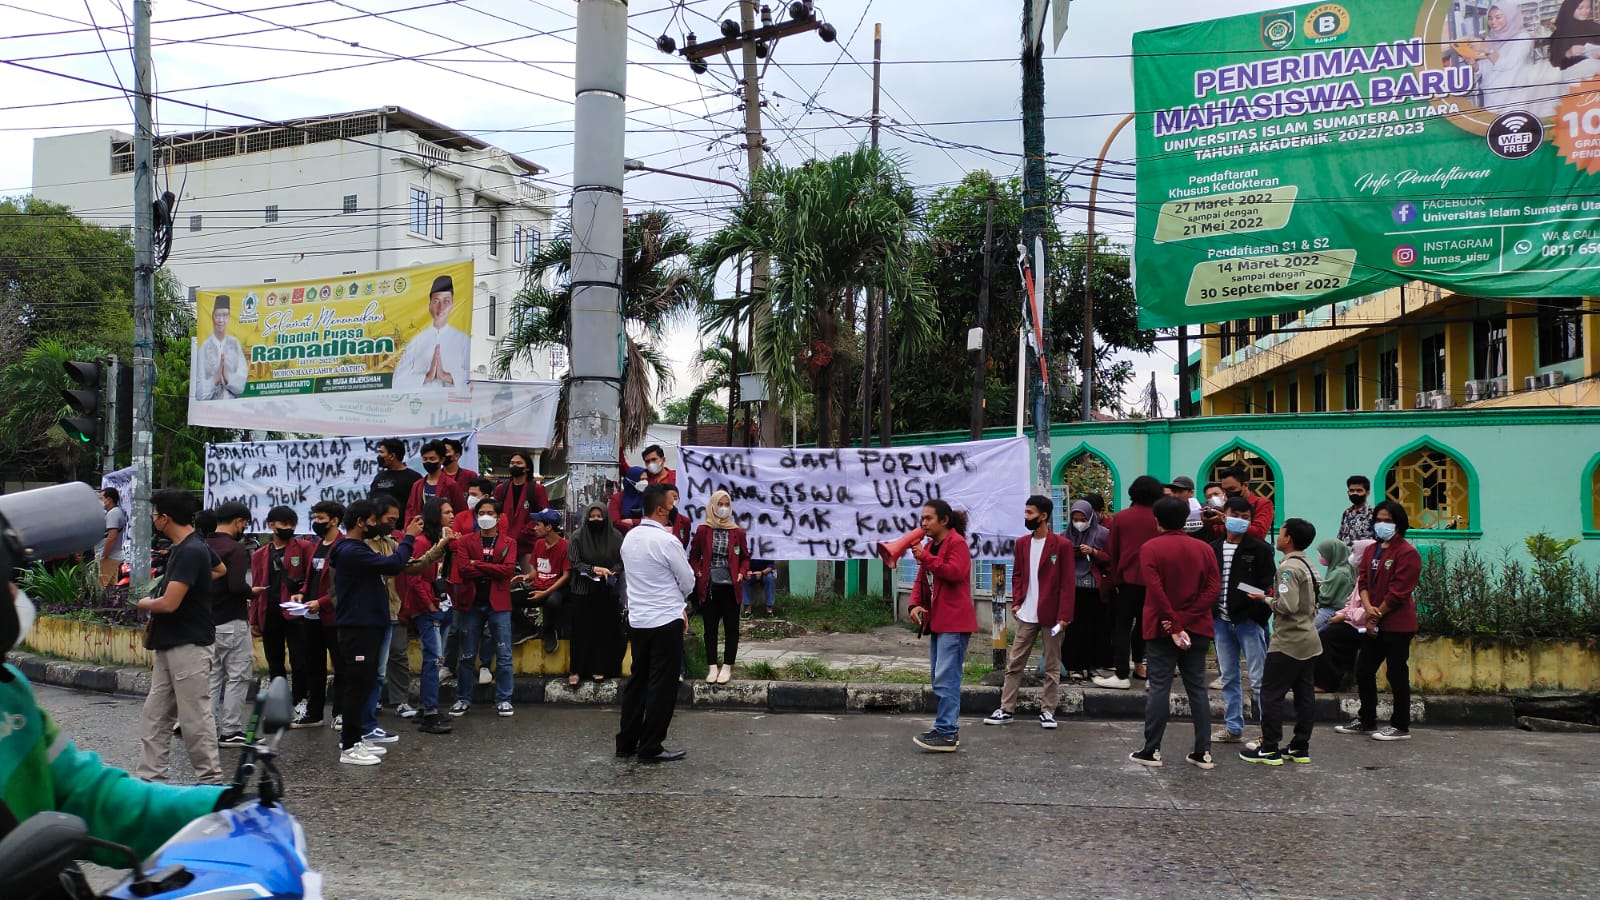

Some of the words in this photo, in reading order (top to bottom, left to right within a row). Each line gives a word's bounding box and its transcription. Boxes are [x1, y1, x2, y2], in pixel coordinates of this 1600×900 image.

[1319, 16, 1336, 33] B
[1195, 38, 1424, 97] PENERIMAAN
[1154, 81, 1365, 137] MAHASISWA
[1369, 66, 1474, 107] BARU
[1164, 128, 1257, 152] UNIVERSITAS
[1262, 121, 1308, 138] ISLAM
[1313, 111, 1400, 131] SUMATERA
[1405, 103, 1459, 121] UTARA
[1195, 144, 1244, 160] TAHUN
[1338, 121, 1425, 142] 2022/2023
[1500, 134, 1532, 145] Wi-Fi
[1503, 144, 1528, 154] FREE
[1189, 169, 1258, 185] Pendaftaran
[1354, 172, 1390, 195] Info
[1393, 166, 1491, 190] Pendaftaran
[1169, 186, 1210, 198] Khusus
[1213, 178, 1279, 192] Kedokteran
[1175, 202, 1190, 214] 27
[1194, 197, 1233, 211] Maret
[1238, 193, 1273, 205] 2022
[1423, 196, 1485, 210] FACEBOOK
[1188, 211, 1220, 222] sampai
[1223, 208, 1259, 218] dengan
[1423, 209, 1486, 222] Universitas
[1490, 208, 1520, 217] Islam
[1524, 203, 1578, 215] Sumatera
[1183, 225, 1197, 236] 21
[1201, 220, 1225, 233] Mei
[1229, 217, 1264, 230] 2022
[1423, 238, 1494, 252] INSTAGRAM
[1542, 232, 1560, 241] WA
[1562, 231, 1570, 241] &
[1207, 244, 1279, 259] Pendaftaran
[1282, 241, 1297, 252] S1
[1301, 240, 1310, 250] &
[1313, 237, 1330, 249] S2
[1542, 243, 1575, 257] 0811
[1218, 262, 1233, 273] 14
[1237, 258, 1279, 271] Maret
[1283, 255, 1320, 268] 2022
[1423, 252, 1490, 265] humas_uisu
[1231, 272, 1266, 283] sampai
[1268, 270, 1306, 280] dengan
[1200, 288, 1218, 299] 30
[1222, 281, 1300, 297] September
[1304, 277, 1341, 290] 2022
[263, 309, 314, 337] Selamat
[277, 330, 319, 345] Ibadah
[323, 328, 364, 341] Puasa
[251, 337, 395, 363] Ramadhan
[252, 463, 277, 479] dan
